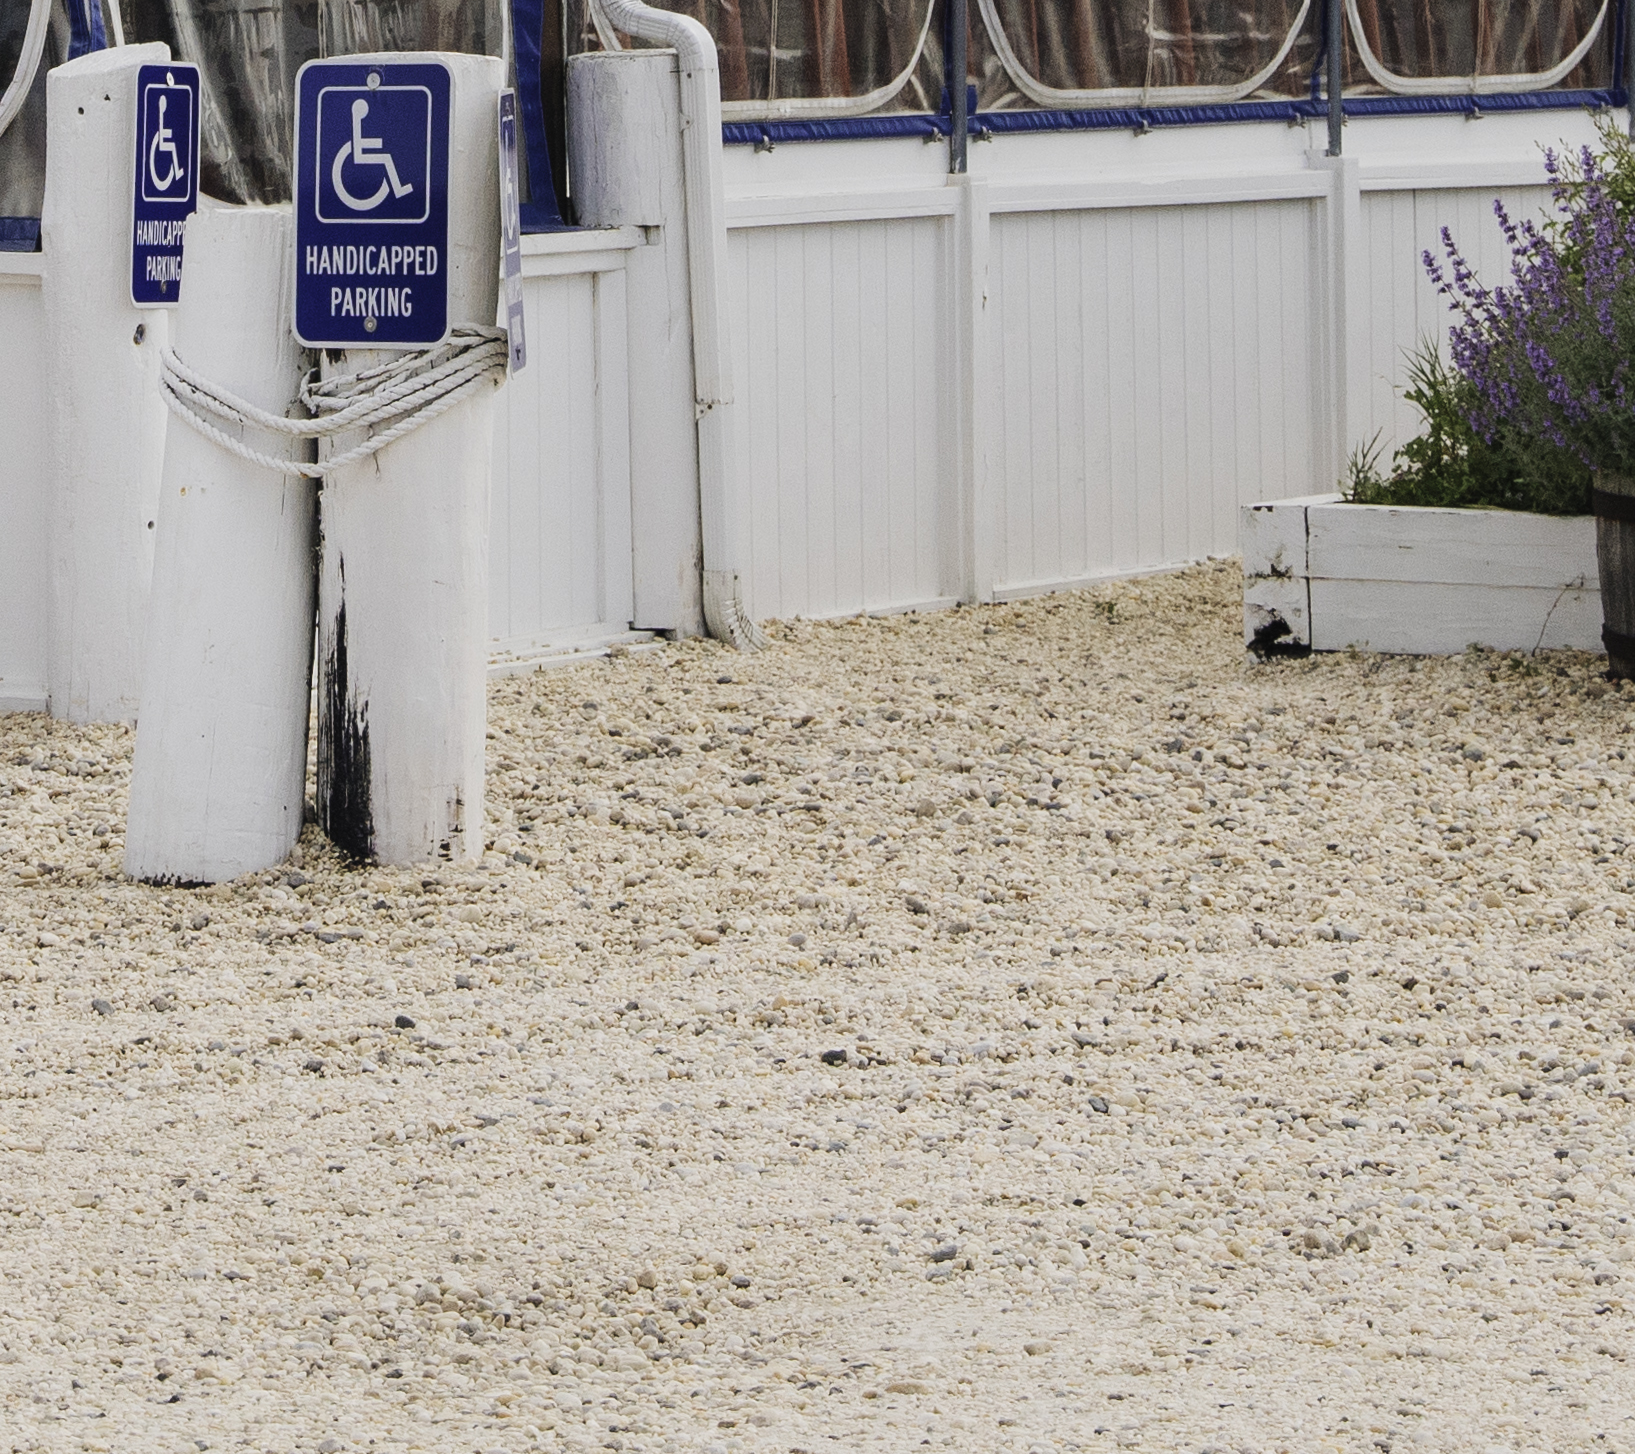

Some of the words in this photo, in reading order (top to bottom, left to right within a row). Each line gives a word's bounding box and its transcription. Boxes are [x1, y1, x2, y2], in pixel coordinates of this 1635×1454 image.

[136, 220, 187, 246] HANDICAPP
[146, 256, 181, 281] PARKING
[306, 245, 438, 275] HANDICAPPED
[330, 287, 412, 317] PARKING
